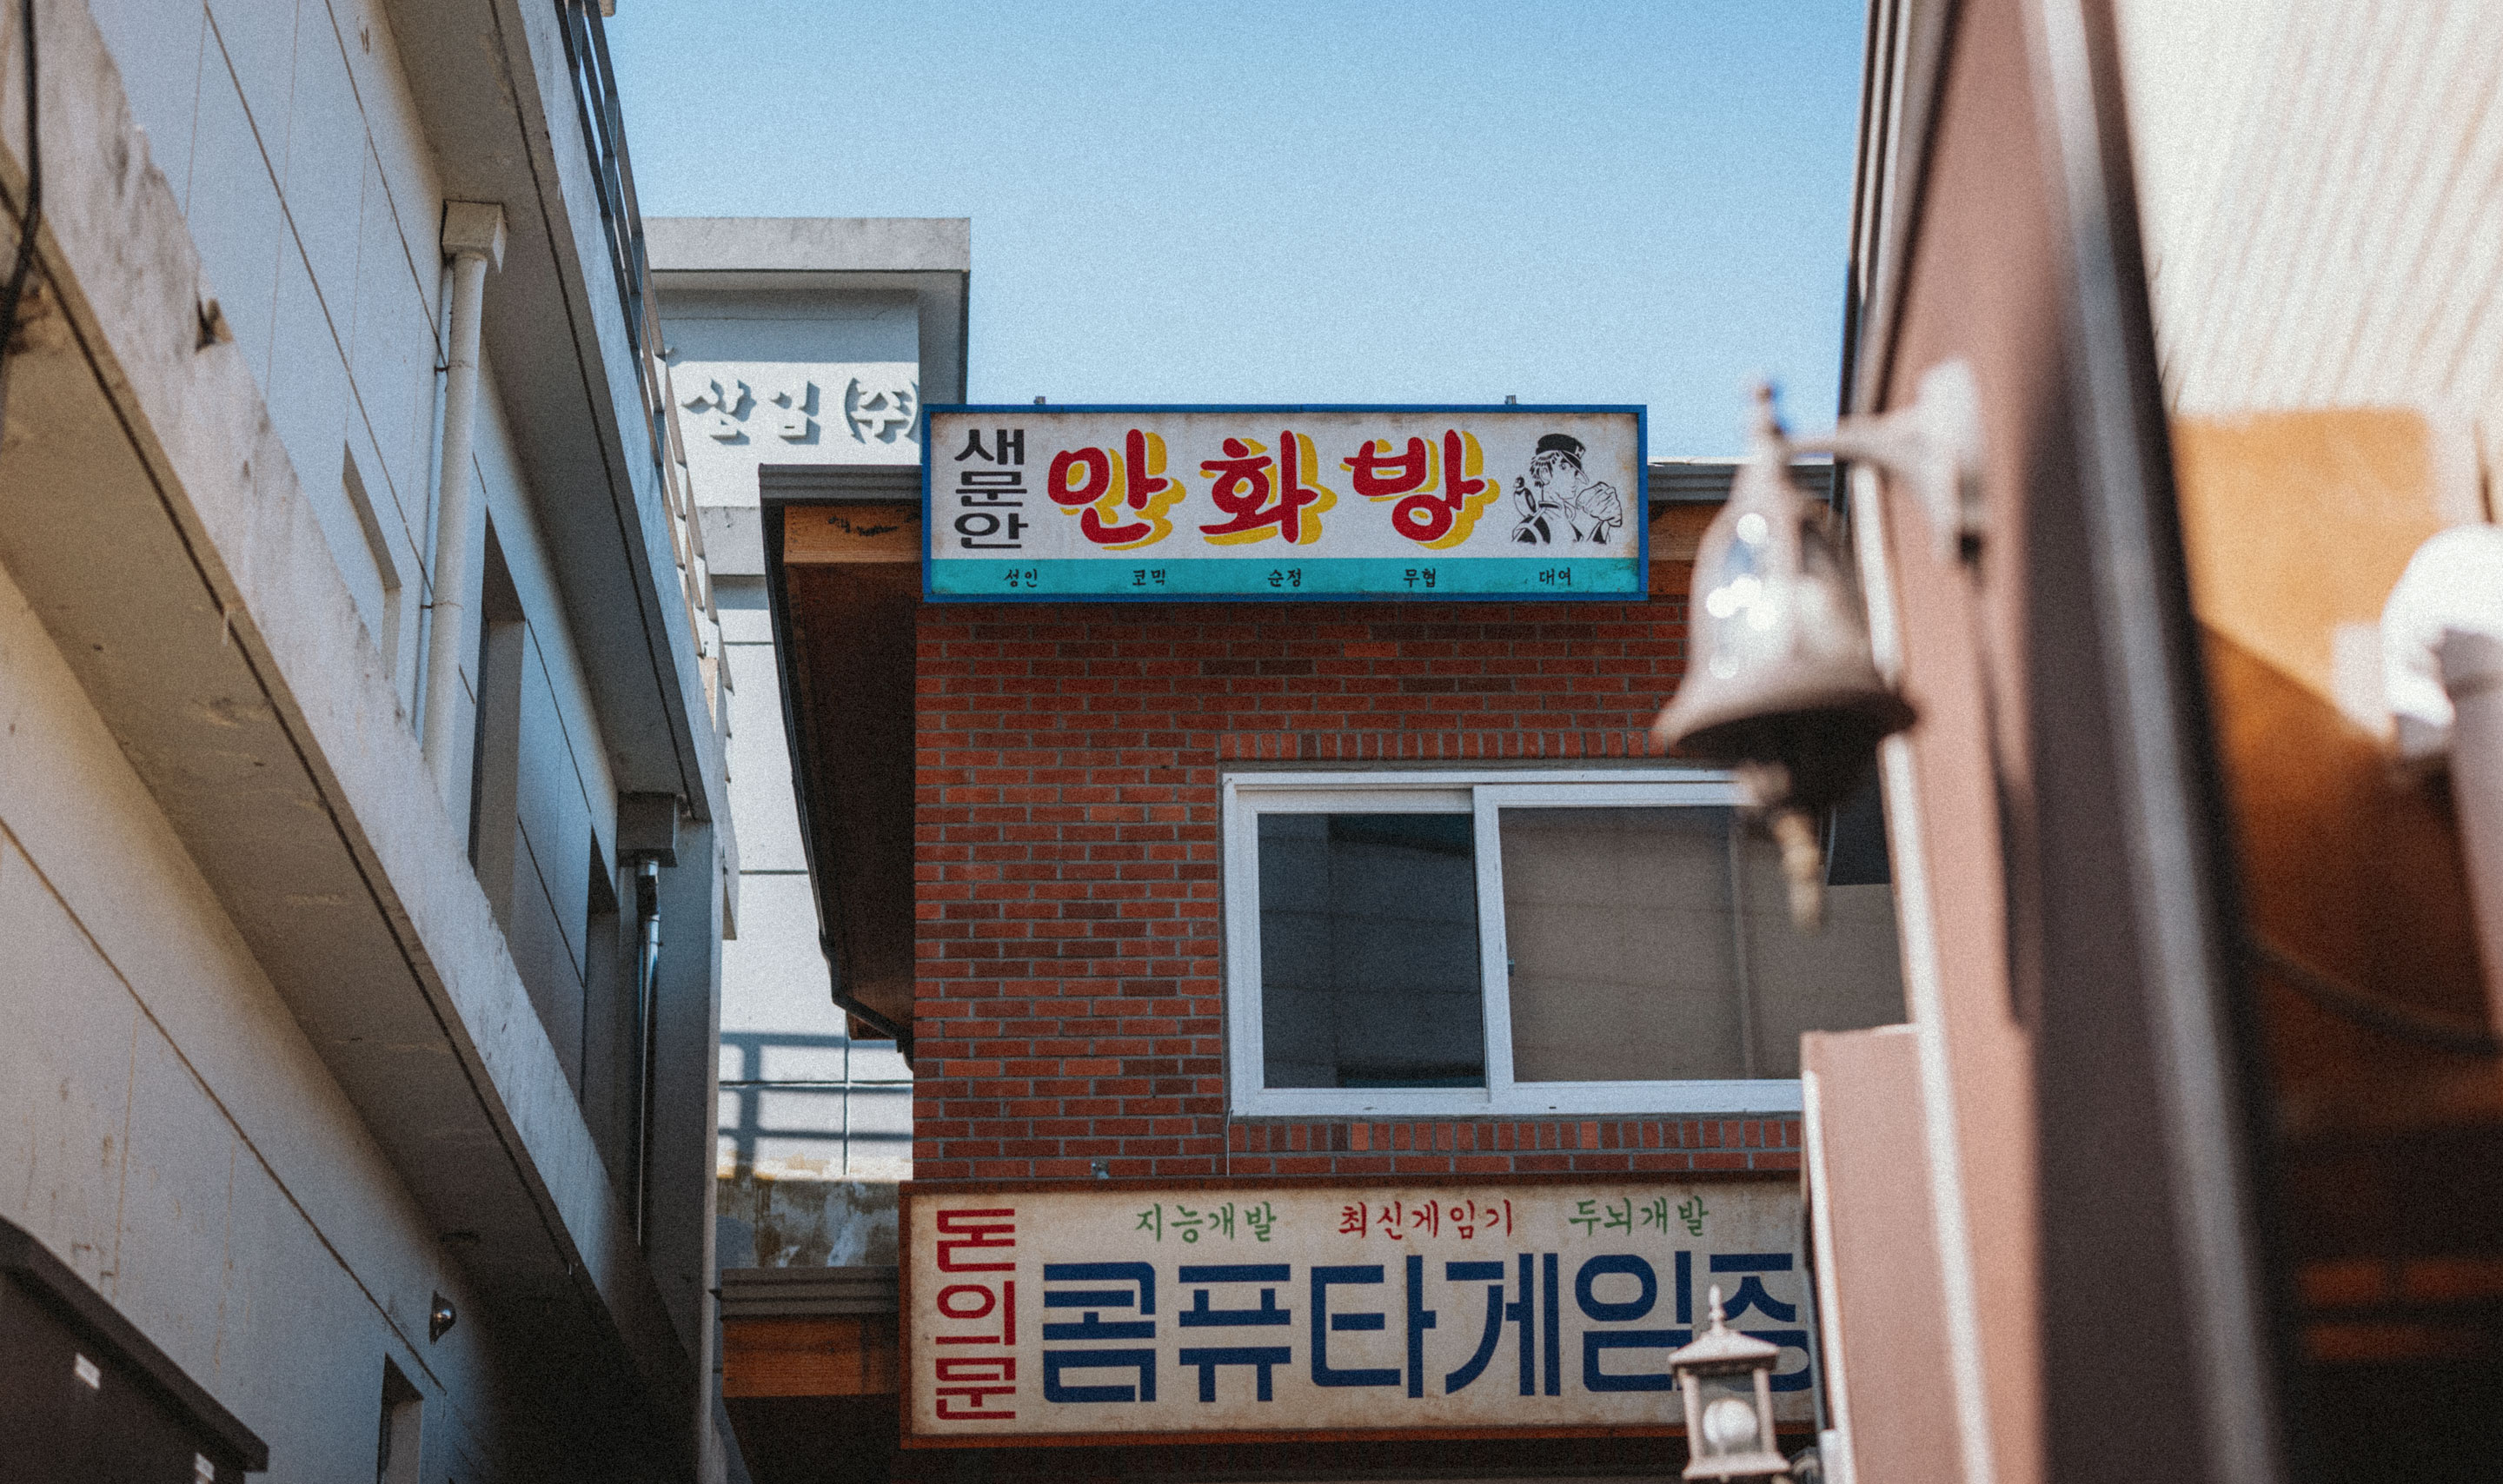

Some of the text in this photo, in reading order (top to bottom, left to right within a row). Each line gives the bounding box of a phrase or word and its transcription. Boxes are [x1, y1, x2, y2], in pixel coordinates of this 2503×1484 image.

[954, 429, 1028, 549] 새문안
[1047, 428, 1500, 550] 만화방
[1004, 567, 1572, 588] 성인 코믹 순정 무협 대여
[1135, 1196, 1710, 1243] 지능개발 최신게임기 두뇌개발
[935, 1209, 1016, 1421] 돈의문
